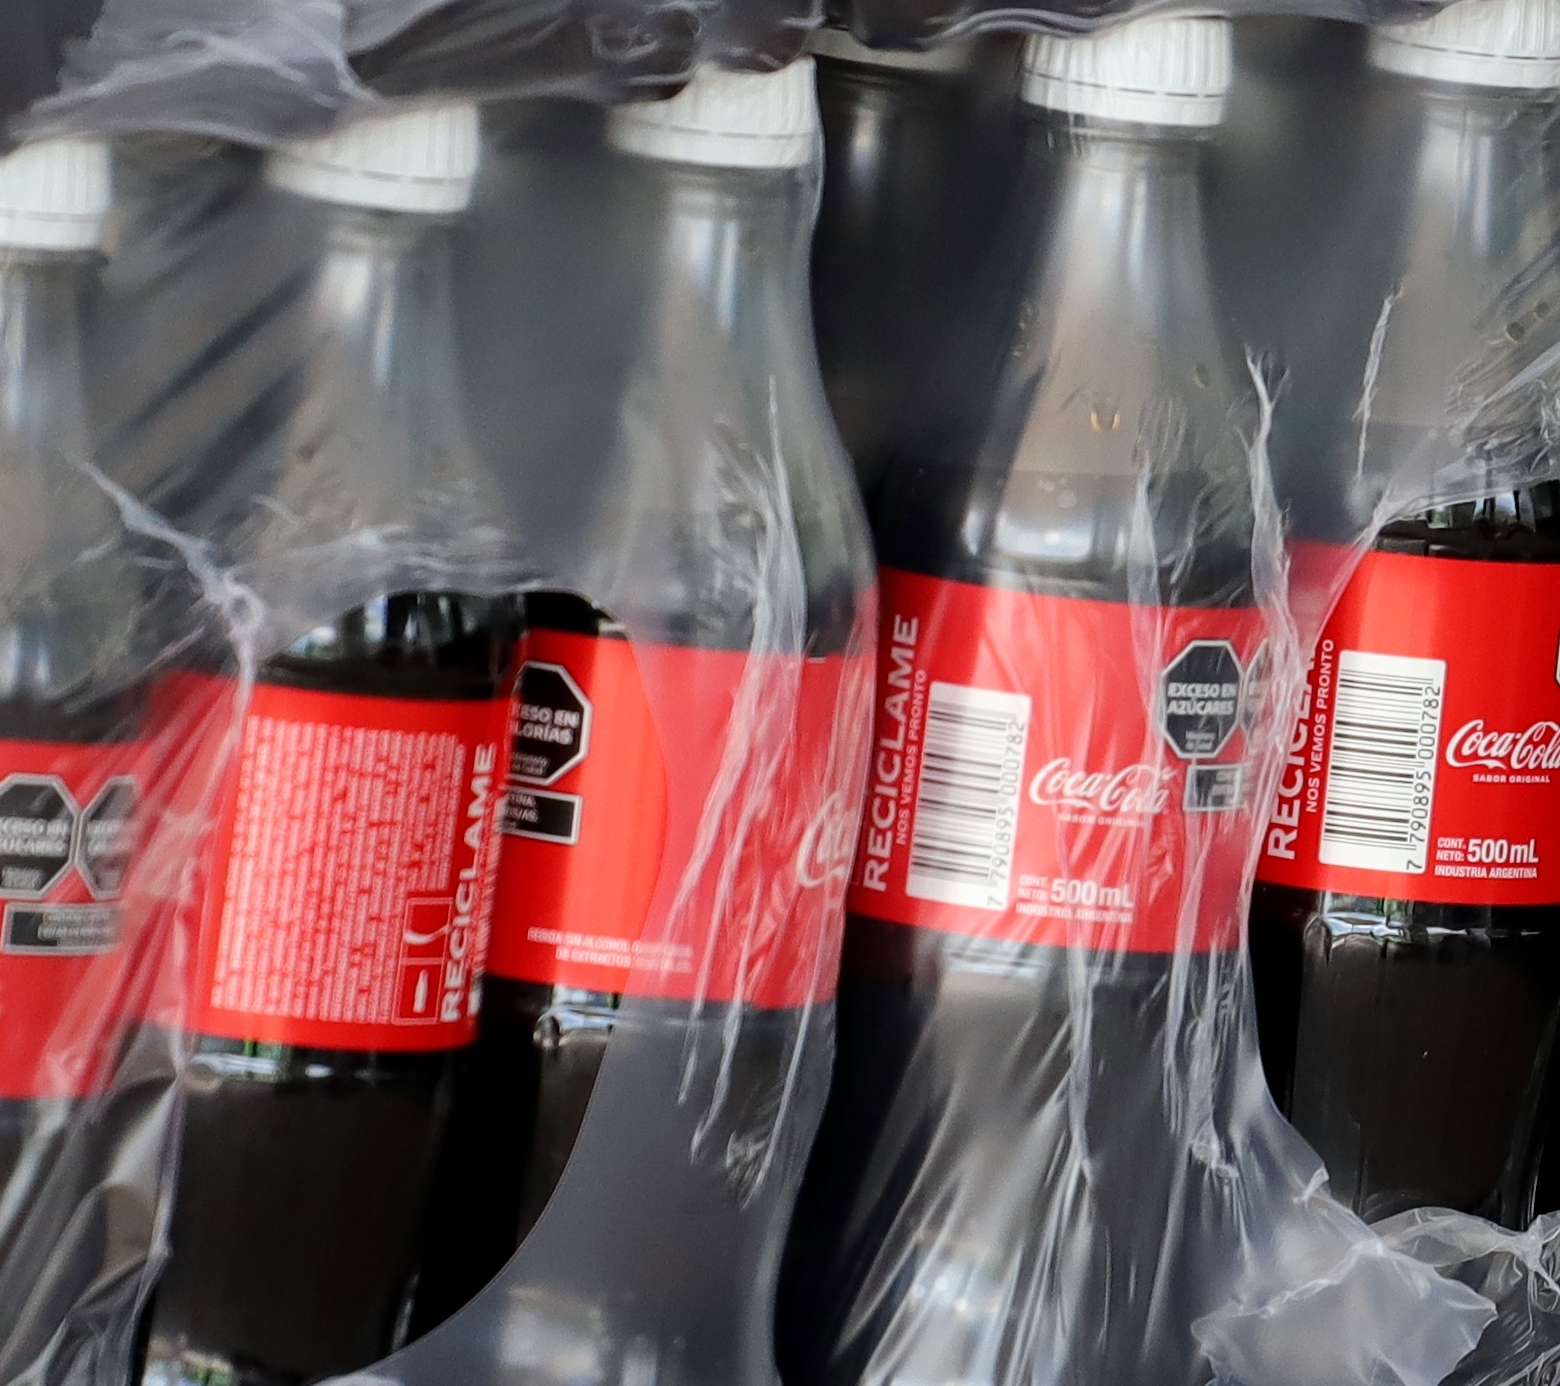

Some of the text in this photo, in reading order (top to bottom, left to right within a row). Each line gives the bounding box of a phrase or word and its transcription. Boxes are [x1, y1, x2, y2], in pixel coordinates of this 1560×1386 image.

[1168, 682, 1219, 698] EXCESO
[1417, 685, 1441, 760] 000782
[862, 614, 920, 893] RECICLAME
[896, 668, 928, 846] NOS VEMOS PRONTO
[1306, 638, 1335, 813] NOS VEMOS PRONTO
[1028, 757, 1178, 814] Coca-Cola
[1408, 770, 1432, 844] 790895
[1472, 773, 1551, 783] SABOR ORIGINAL
[1434, 865, 1538, 879] INDUSTRIA ARGENTINA
[1435, 849, 1465, 862] NETO:
[1437, 836, 1466, 850] CONT.
[442, 742, 496, 1023] RECICLAME
